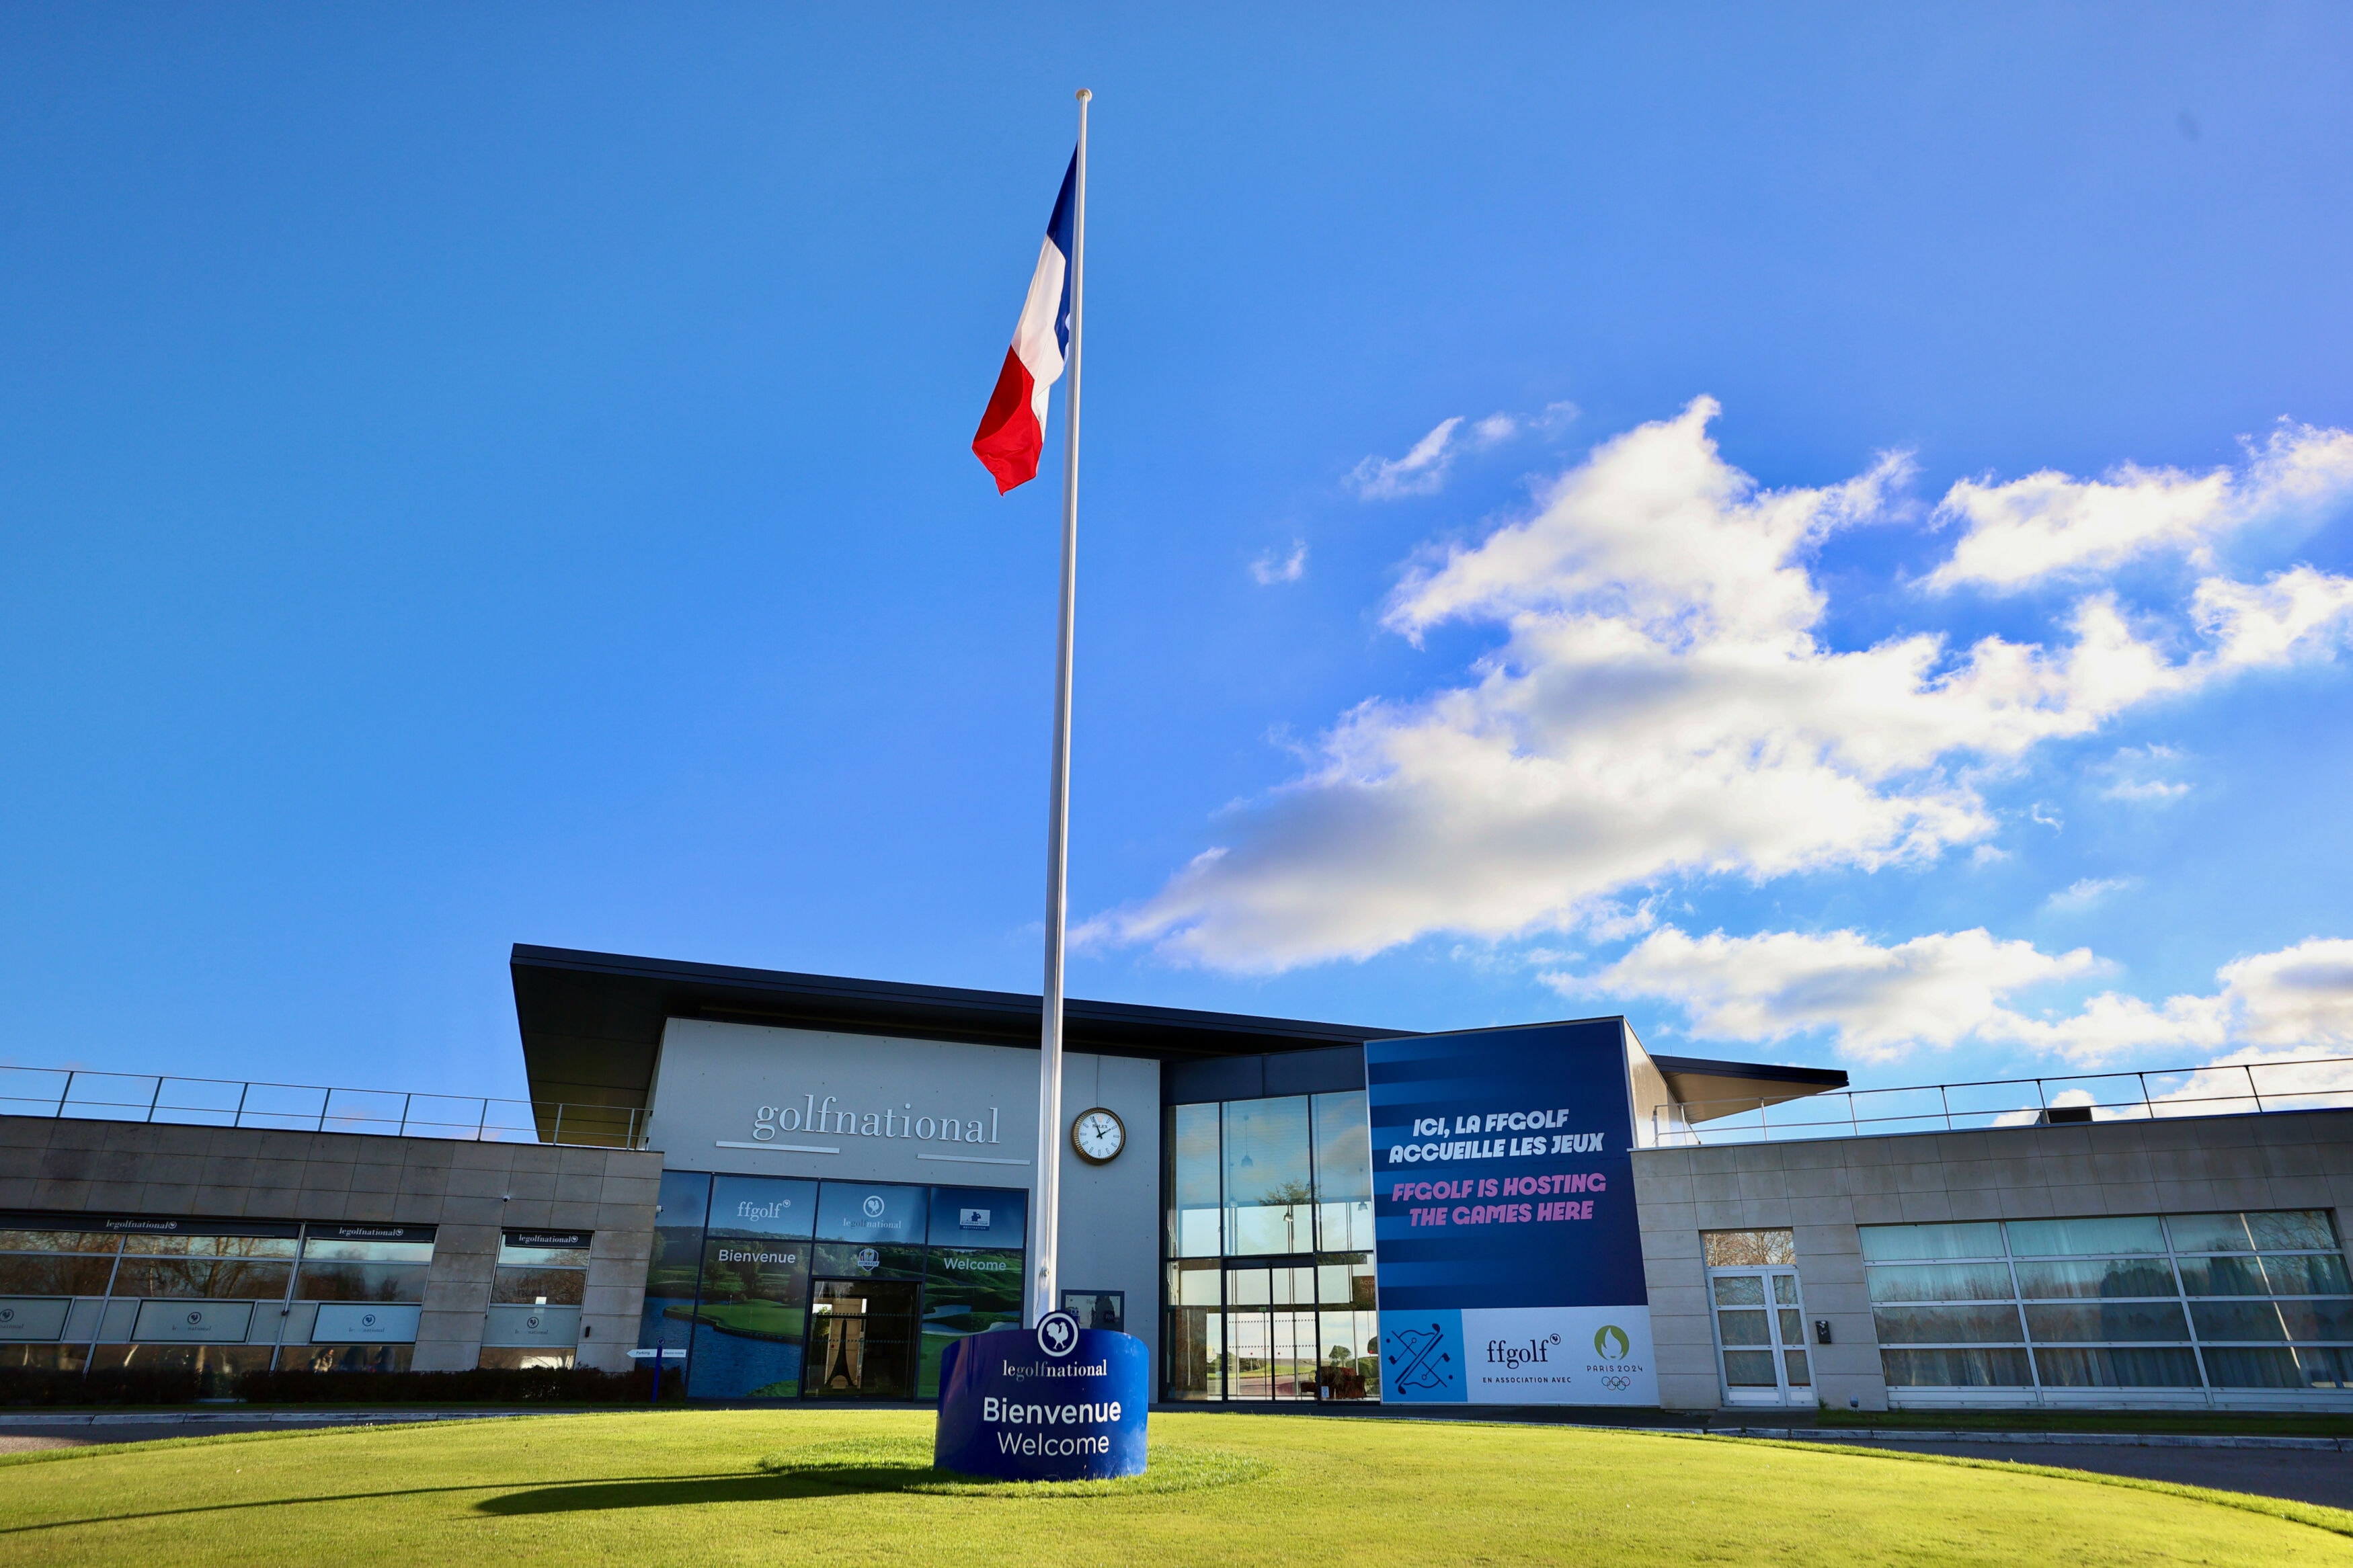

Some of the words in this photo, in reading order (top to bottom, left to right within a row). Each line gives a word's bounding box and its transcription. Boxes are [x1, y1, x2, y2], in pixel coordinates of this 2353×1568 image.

[752, 1094, 1000, 1143] golfnational
[1412, 1117, 1449, 1139] ICI,
[1455, 1115, 1481, 1134] LA
[1484, 1109, 1569, 1132] FFGOLF
[1389, 1139, 1506, 1163] ACCUEILLE
[1509, 1137, 1547, 1157] LES
[1551, 1132, 1604, 1154] JEUX
[1392, 1180, 1474, 1202] FFGOLF
[1478, 1178, 1498, 1198] IS
[1503, 1173, 1607, 1196] HOSTING
[737, 1201, 782, 1222] ffgolf
[1410, 1206, 1447, 1227] THE
[1452, 1203, 1532, 1225] GAMES
[1537, 1200, 1594, 1222] HERE
[106, 1219, 169, 1229] legolfnational
[339, 1227, 395, 1237] legolfnational
[843, 1218, 902, 1229] legolfnational
[519, 1234, 571, 1243] legolfnational
[719, 1249, 796, 1264] Bienvenue
[943, 1257, 1006, 1271] Welcome
[1486, 1339, 1550, 1370] ffgolf
[1002, 1359, 1107, 1382] legolfnational
[1587, 1364, 1615, 1372] PARIS
[984, 1397, 1121, 1424] Bienvenue
[997, 1432, 1110, 1456] Welcome
